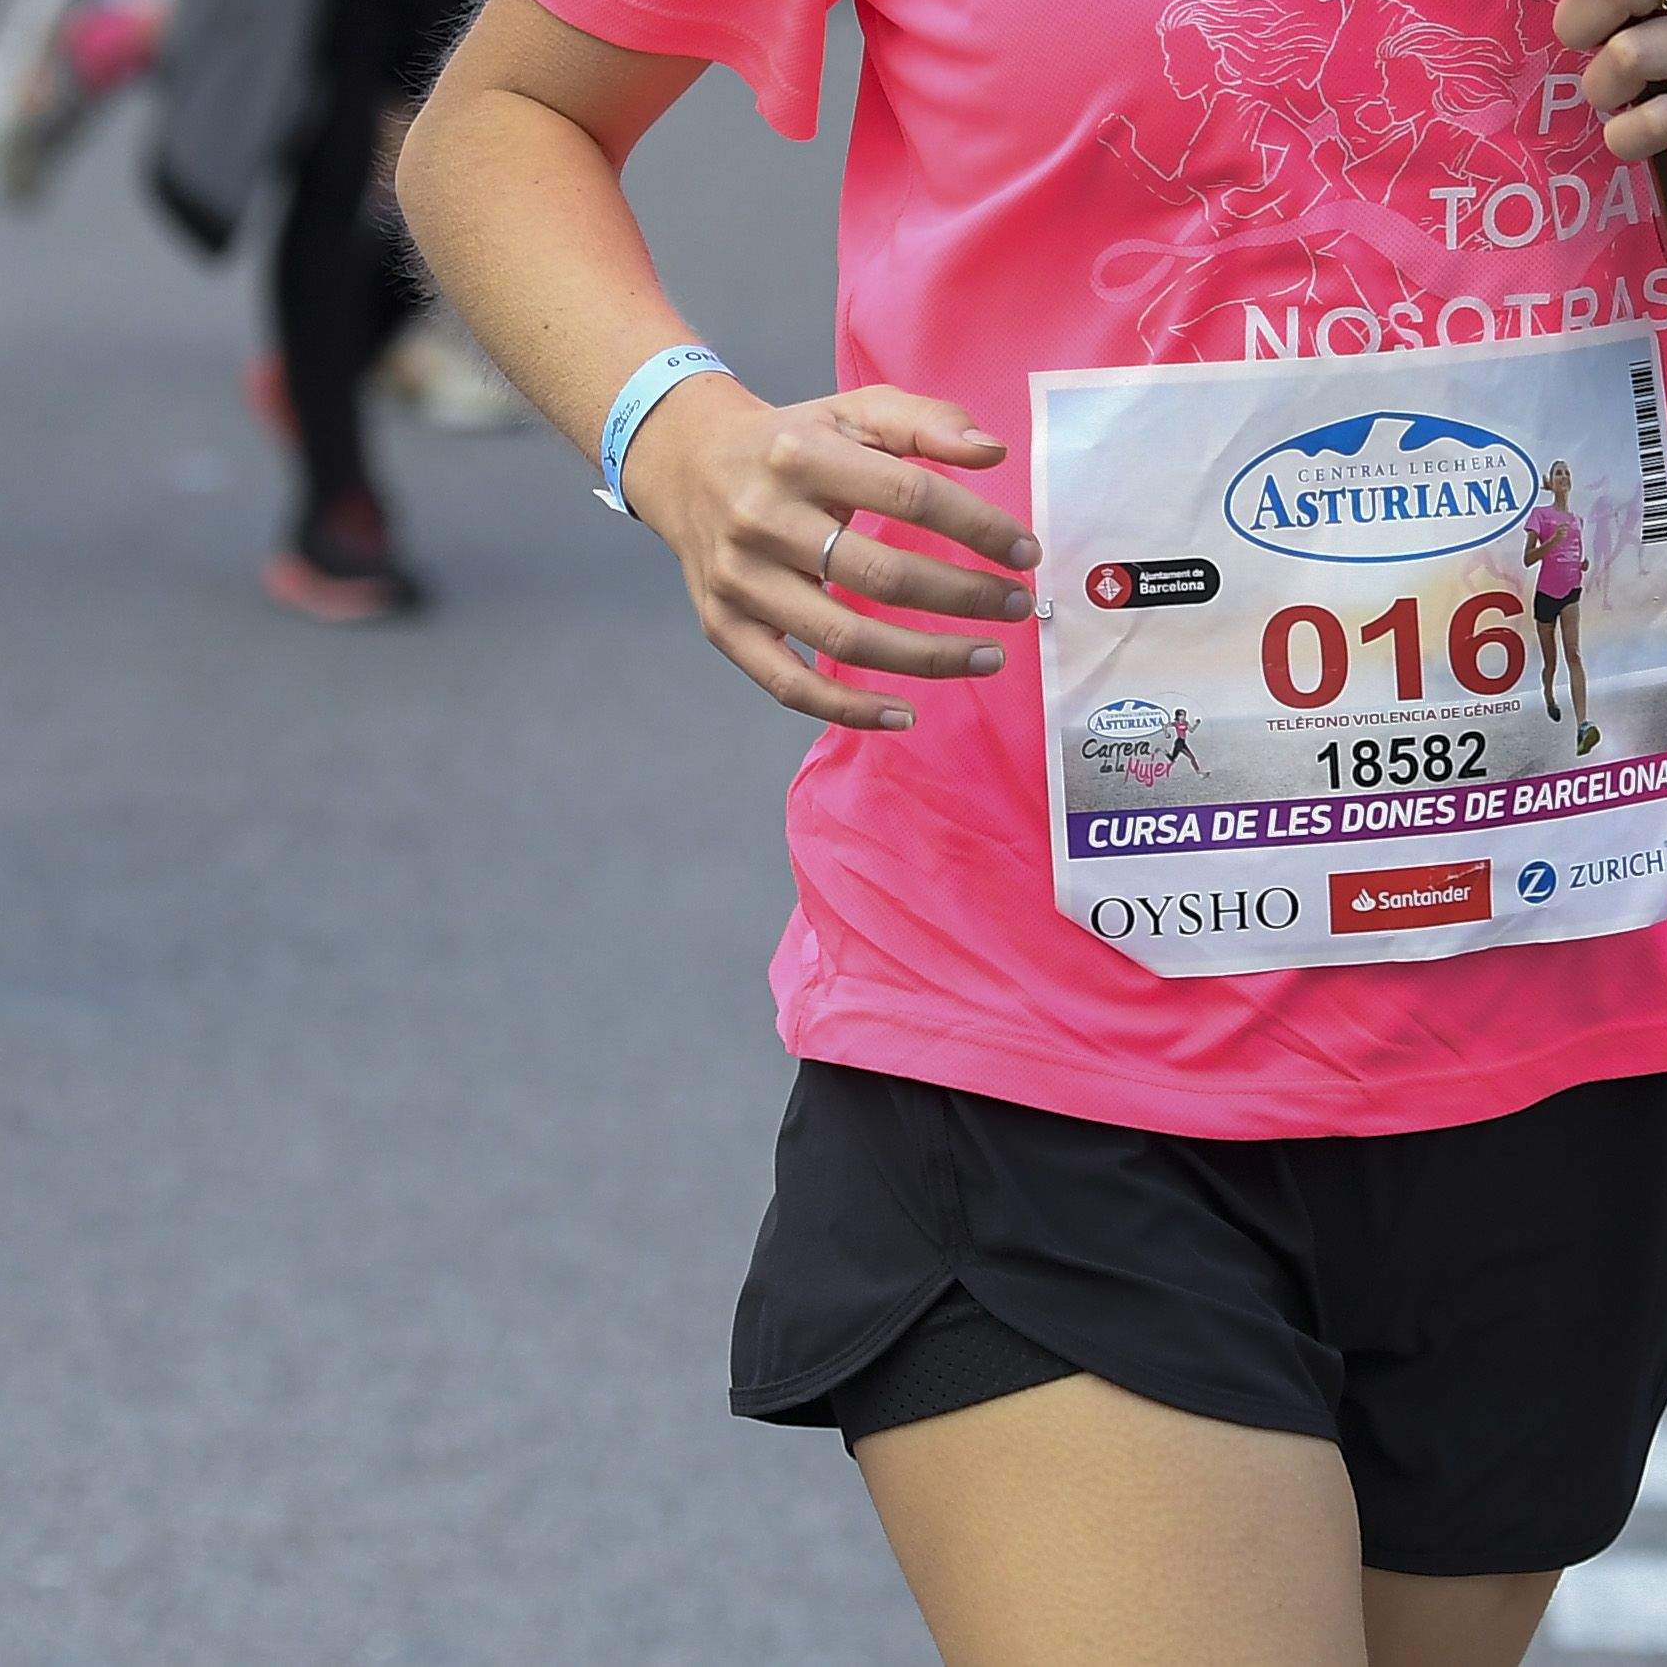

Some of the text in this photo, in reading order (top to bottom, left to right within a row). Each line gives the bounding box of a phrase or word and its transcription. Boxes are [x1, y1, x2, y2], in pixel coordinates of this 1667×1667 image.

[1297, 454, 1507, 483] CENTRAL LECHERA
[1249, 474, 1520, 531] ASTURIANA
[1139, 569, 1204, 582] Ajuntament de
[1139, 580, 1205, 594] Barcelona
[1261, 591, 1526, 710] 016
[1094, 716, 1164, 731] ASTURIANA
[1266, 699, 1521, 731] TELÉFONO VIOLENCIA DE GÉNERO
[1081, 738, 1151, 759] Carrera
[1316, 730, 1488, 790] 18582
[1099, 759, 1112, 773] de
[1124, 754, 1173, 787] Mujer
[1087, 813, 1201, 849] CURSA
[1211, 809, 1261, 842] DE
[1267, 804, 1333, 838] LES
[1341, 795, 1456, 833] DONES
[1464, 785, 1506, 822] DE
[1569, 849, 1665, 889] ZURICH
[1089, 887, 1301, 940] OYSHO
[1377, 885, 1472, 911] Santander
